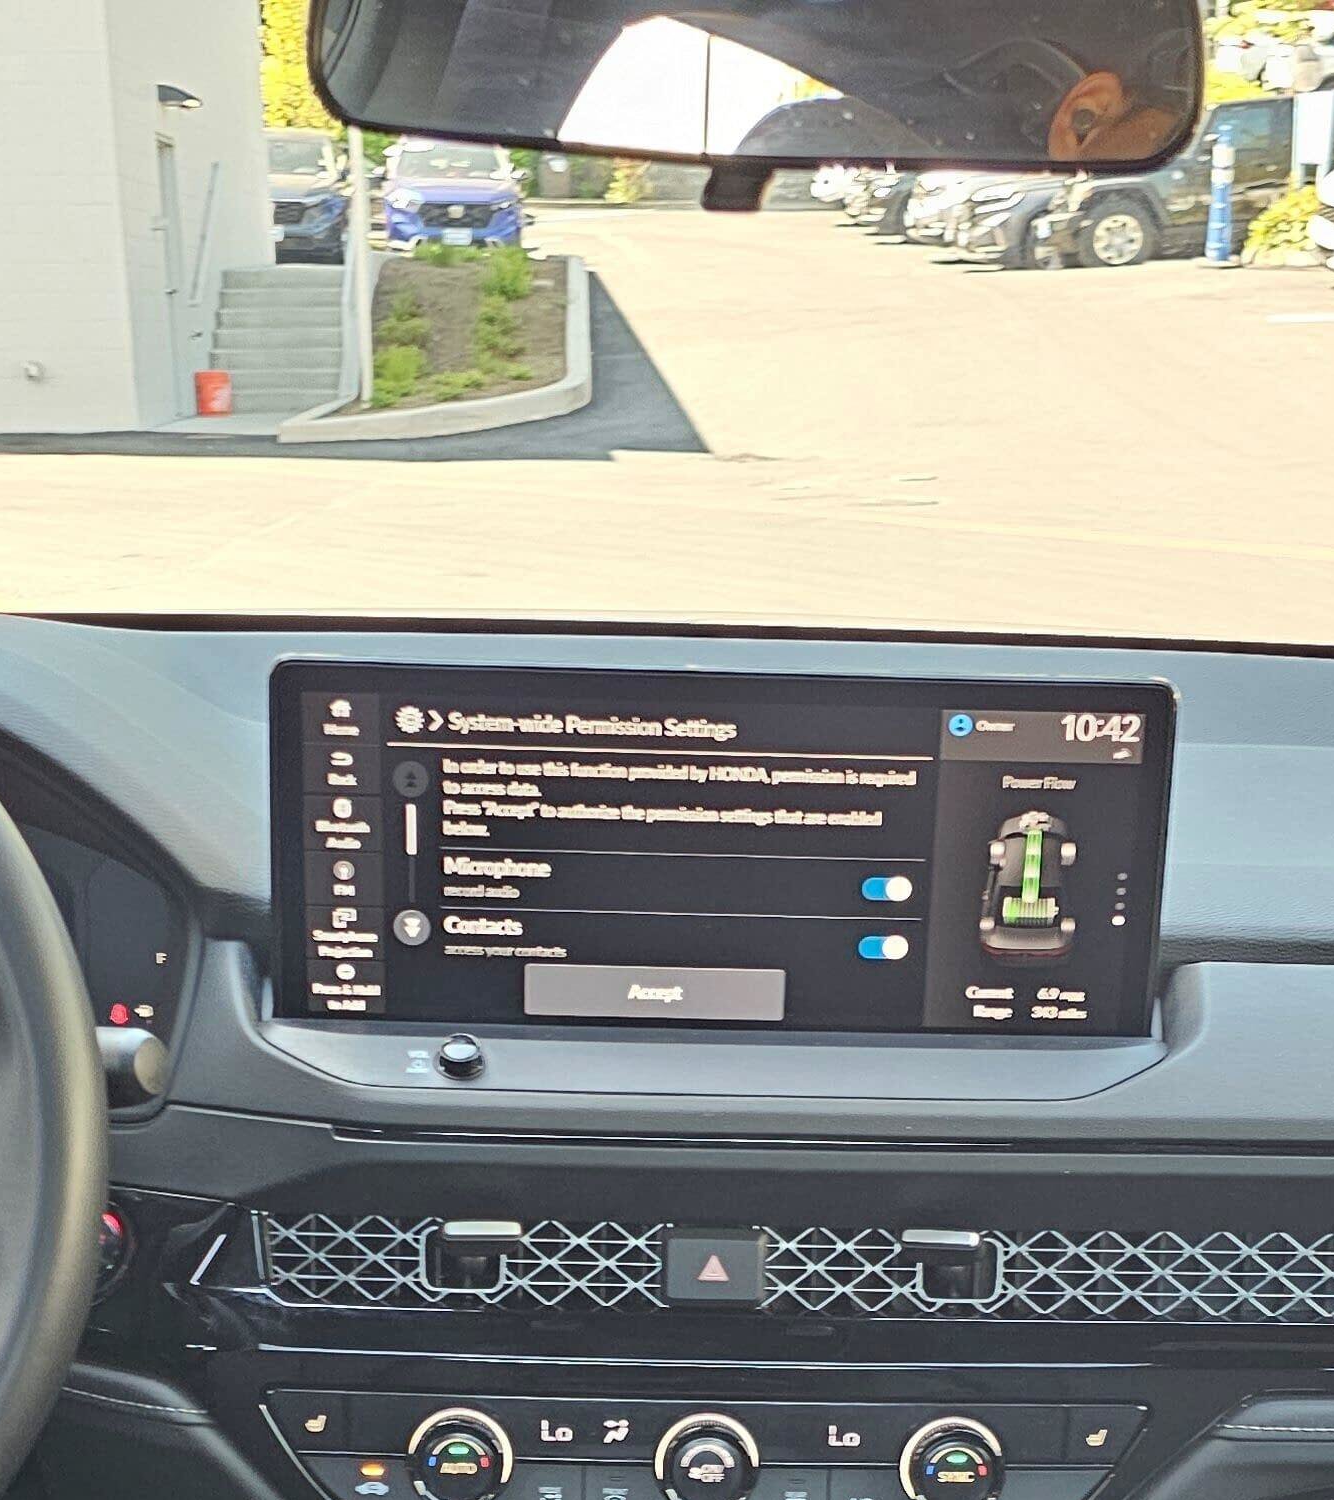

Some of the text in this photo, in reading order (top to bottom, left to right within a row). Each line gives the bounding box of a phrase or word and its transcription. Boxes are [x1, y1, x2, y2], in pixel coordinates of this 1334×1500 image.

[447, 711, 738, 742] System-wide Permission Settings
[1060, 714, 1142, 743] 10:42
[443, 856, 553, 880] Microphone
[443, 915, 524, 936] Contacts
[627, 984, 684, 1004] Accept
[539, 1419, 573, 1442] Lo
[827, 1424, 861, 1447] Lo
